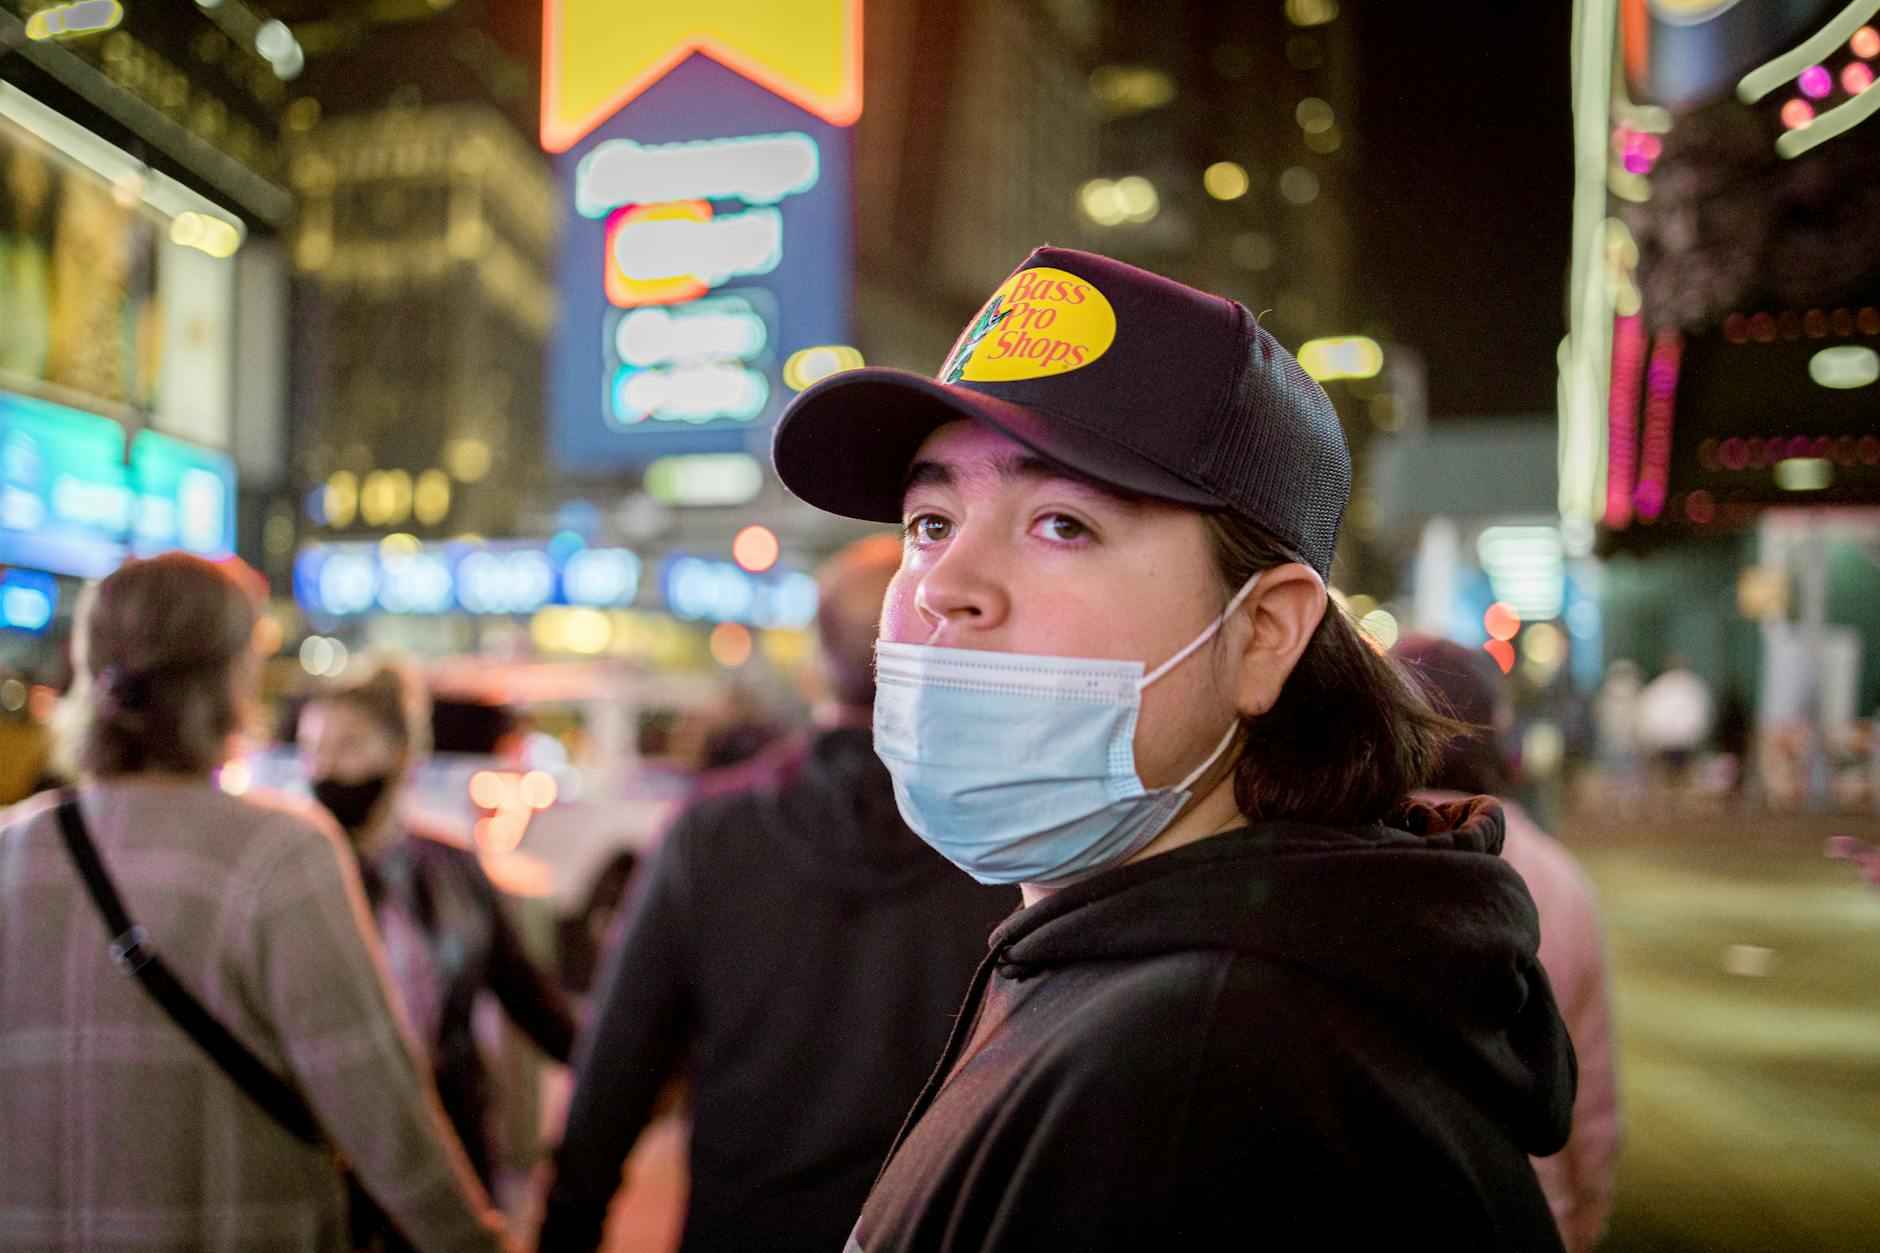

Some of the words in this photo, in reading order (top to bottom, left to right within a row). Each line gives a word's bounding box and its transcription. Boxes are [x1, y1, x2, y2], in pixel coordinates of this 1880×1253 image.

[1008, 271, 1090, 304] Bass
[1000, 302, 1057, 331] Pro
[987, 331, 1089, 368] Shops
